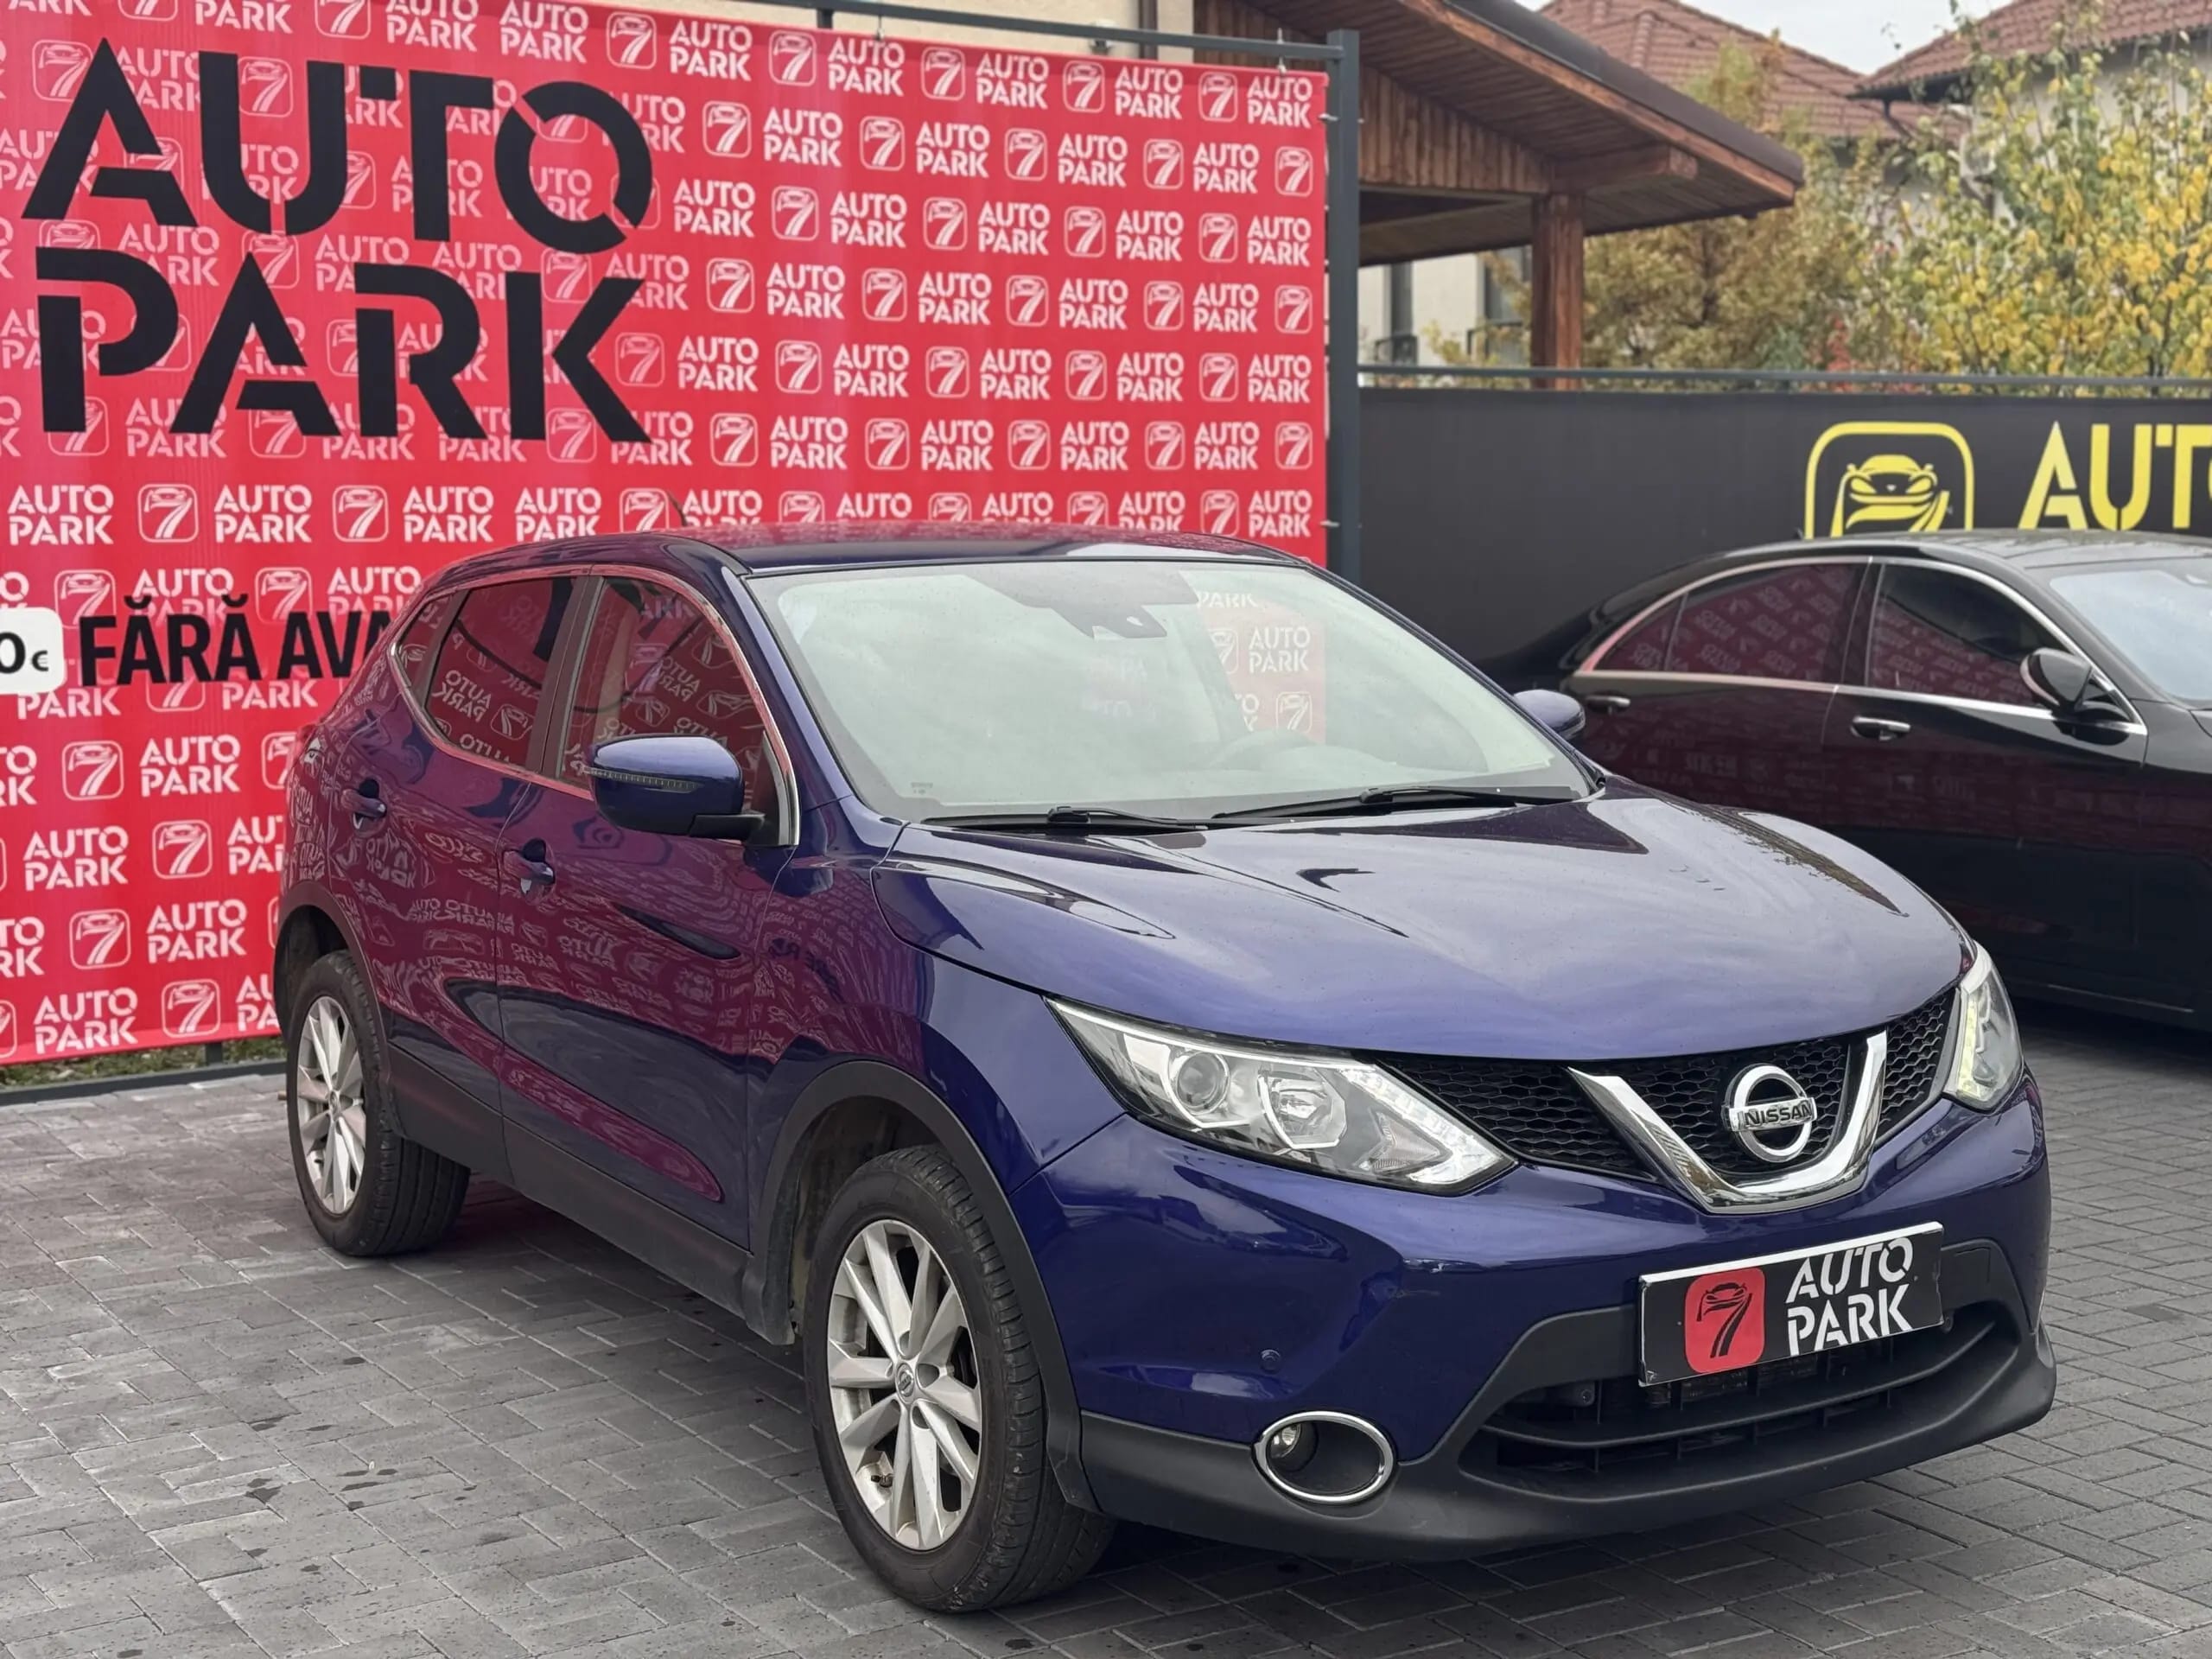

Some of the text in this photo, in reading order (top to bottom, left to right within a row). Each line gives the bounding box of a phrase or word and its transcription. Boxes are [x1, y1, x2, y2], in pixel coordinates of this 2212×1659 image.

[195, 0, 292, 33] PARK
[499, 0, 588, 34] AUTO
[387, 15, 477, 52] PARK
[501, 26, 586, 63] PARK
[670, 21, 752, 52] AUTO
[671, 46, 751, 80] PARK
[828, 37, 905, 68] AUTO
[829, 63, 903, 96] PARK
[976, 54, 1049, 82] AUTO
[1116, 67, 1182, 94] AUTO
[977, 77, 1047, 109] PARK
[1247, 76, 1313, 102] AUTO
[1116, 90, 1181, 119] PARK
[1248, 99, 1310, 128] PARK
[763, 107, 842, 139] AUTO
[916, 122, 990, 150] AUTO
[22, 37, 653, 254] AUTO
[764, 133, 842, 167] PARK
[1058, 134, 1128, 161] AUTO
[1193, 143, 1259, 169] AUTO
[917, 147, 988, 177] PARK
[1058, 157, 1126, 187] PARK
[673, 179, 755, 209] AUTO
[1193, 166, 1257, 194] PARK
[830, 192, 907, 220] AUTO
[978, 202, 1050, 228] AUTO
[674, 205, 753, 237] PARK
[831, 217, 906, 247] PARK
[1116, 211, 1184, 236] AUTO
[1247, 217, 1311, 242] AUTO
[118, 223, 219, 255] AUTO
[315, 234, 410, 264] AUTO
[978, 226, 1048, 255] PARK
[1116, 234, 1182, 261] PARK
[1248, 238, 1310, 266] PARK
[432, 242, 522, 271] AUTO
[606, 253, 690, 283] AUTO
[766, 263, 845, 292] AUTO
[918, 272, 991, 298] AUTO
[1058, 278, 1128, 305] AUTO
[767, 289, 844, 319] PARK
[1193, 283, 1259, 308] AUTO
[918, 296, 989, 325] PARK
[1059, 302, 1127, 329] PARK
[1193, 306, 1257, 332] PARK
[35, 245, 652, 443] PARK
[677, 336, 759, 365] AUTO
[833, 344, 909, 371] AUTO
[980, 349, 1052, 374] AUTO
[1116, 353, 1184, 377] AUTO
[1248, 355, 1312, 379] AUTO
[678, 362, 758, 391] PARK
[834, 369, 908, 397] PARK
[980, 372, 1050, 399] PARK
[1117, 376, 1182, 401] PARK
[1249, 378, 1310, 403] PARK
[127, 428, 226, 458] PARK
[770, 416, 848, 442] AUTO
[920, 420, 994, 445] AUTO
[1060, 422, 1129, 445] AUTO
[1194, 422, 1260, 447] AUTO
[771, 441, 847, 469] PARK
[921, 444, 992, 470] PARK
[1061, 445, 1128, 470] PARK
[1195, 444, 1258, 469] PARK
[2018, 421, 2212, 531] AUT
[7, 485, 114, 514] AUTO
[214, 485, 312, 513] AUTO
[403, 486, 493, 514] AUTO
[515, 487, 601, 514] AUTO
[683, 490, 762, 516] AUTO
[836, 493, 912, 518] AUTO
[982, 492, 1053, 517] AUTO
[1119, 491, 1185, 515] AUTO
[1249, 490, 1313, 513] AUTO
[9, 515, 113, 545] PARK
[215, 513, 312, 543] PARK
[404, 514, 493, 542] PARK
[1249, 513, 1310, 537] PARK
[132, 568, 234, 598] AUTO
[327, 566, 423, 594] AUTO
[79, 594, 263, 688] FĂRĂ
[1249, 626, 1311, 650] AUTO
[1249, 650, 1309, 673] PARK
[222, 679, 318, 710] PARK
[139, 734, 240, 767] AUTO
[141, 763, 240, 798] PARK
[23, 826, 129, 861] AUTO
[25, 855, 128, 891] PARK
[147, 899, 247, 934] AUTO
[148, 927, 246, 963] PARK
[34, 988, 137, 1025] AUTO
[35, 1016, 138, 1054] PARK
[1745, 1102, 1813, 1126] NISSAN
[1786, 1237, 1913, 1304] AUTO
[1788, 1284, 1913, 1356] PARK
